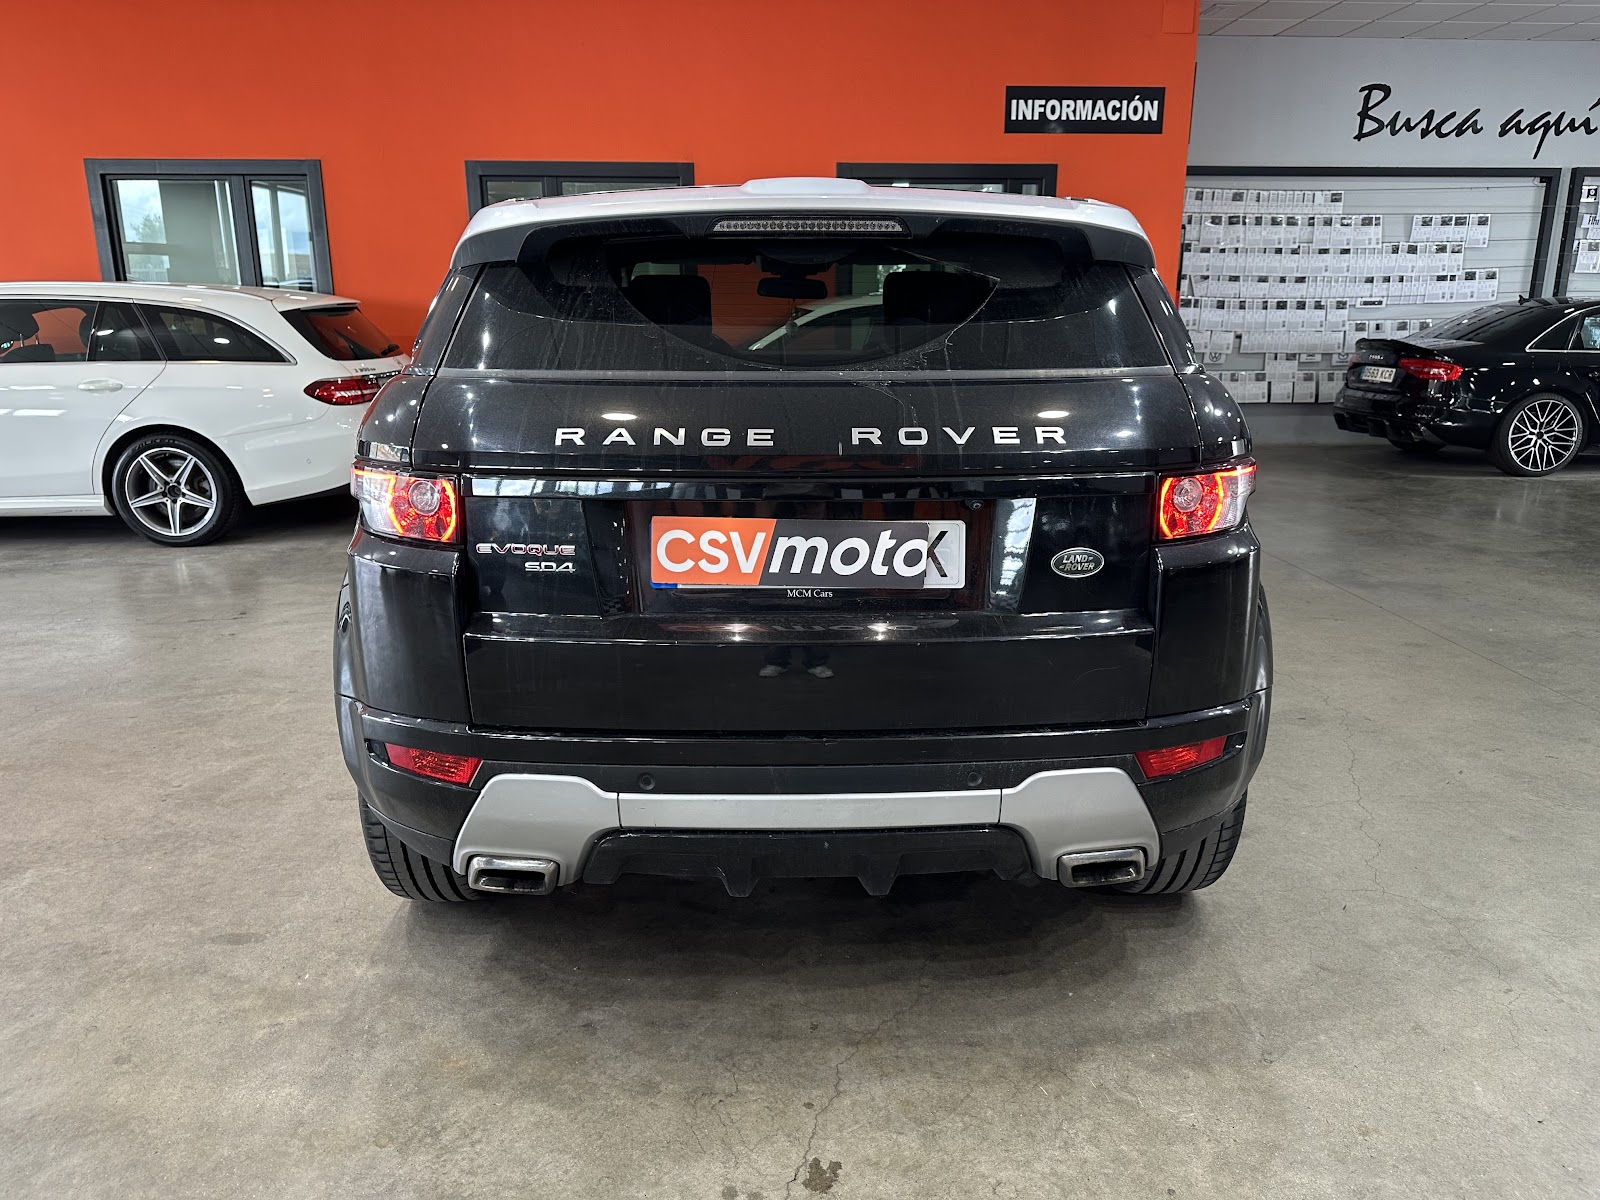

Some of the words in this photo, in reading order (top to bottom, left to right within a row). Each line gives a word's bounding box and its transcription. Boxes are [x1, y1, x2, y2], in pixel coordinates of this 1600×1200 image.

[1010, 95, 1159, 121] INFORMACIÓN
[1353, 83, 1483, 141] Busca
[1498, 98, 1600, 159] aquí
[554, 427, 775, 447] RANGE
[851, 426, 1067, 446] ROVER
[476, 543, 576, 556] EVOQUE
[1062, 554, 1088, 563] LAND
[525, 562, 576, 573] SD4
[1064, 562, 1095, 571] ROVER
[787, 589, 811, 598] MCM
[813, 589, 833, 598] Cars
